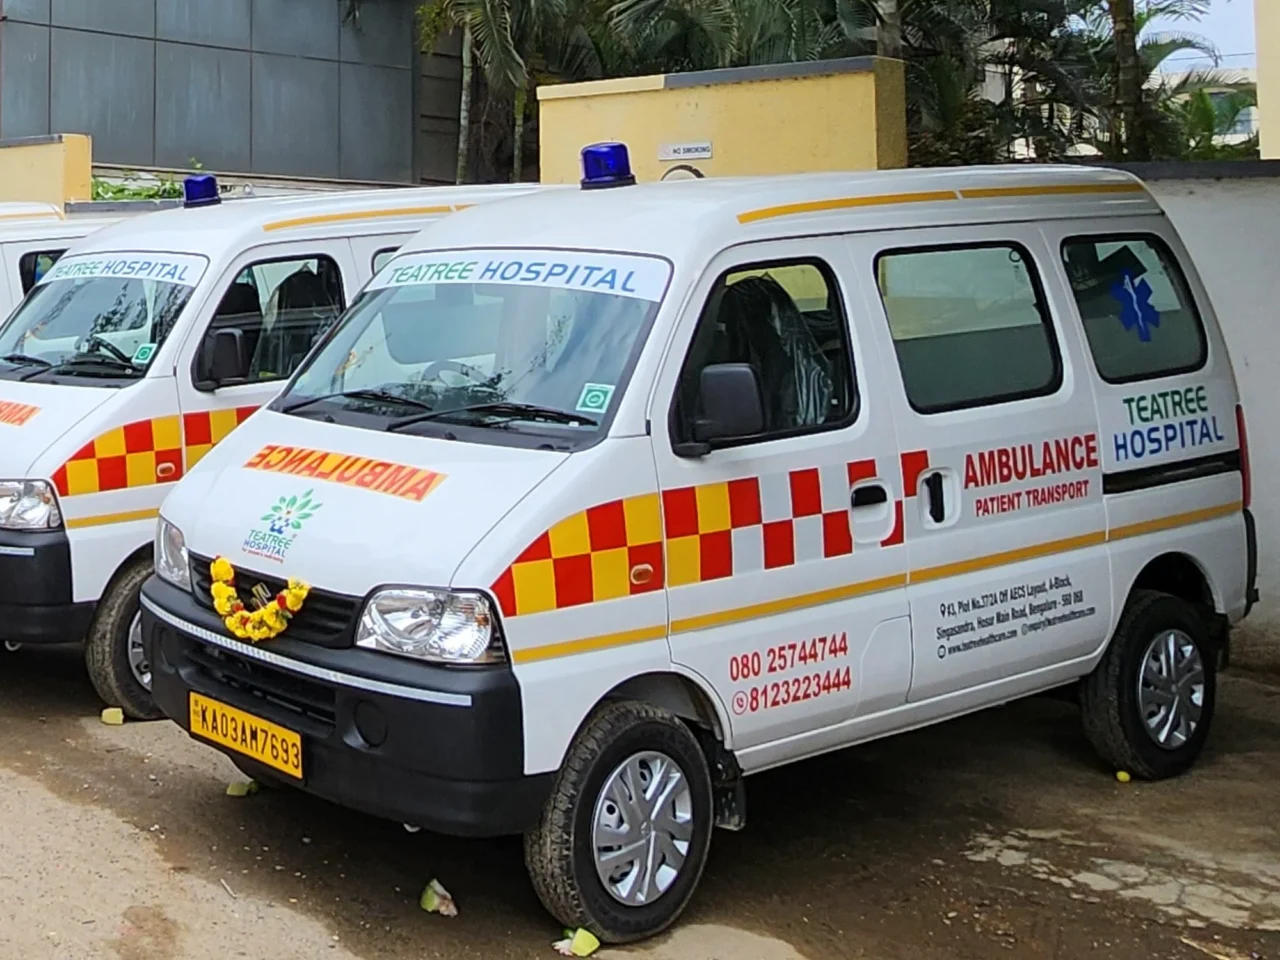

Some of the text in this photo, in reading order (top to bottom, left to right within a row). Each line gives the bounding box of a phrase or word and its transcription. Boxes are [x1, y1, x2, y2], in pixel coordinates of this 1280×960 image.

[100, 260, 189, 281] HOSPITAL
[386, 261, 636, 293] TEATREE HOSPITAL
[1123, 385, 1208, 425] TEATREE
[1113, 416, 1224, 462] HOSPITAL
[964, 433, 1098, 490] AMBULANCE
[975, 480, 1089, 517] PATIENT TRANSPORT
[244, 540, 285, 558] HOSPITAL
[248, 529, 293, 550] TEATREE
[957, 599, 971, 614] Plot
[1010, 585, 1026, 601] AECS
[996, 611, 1010, 624] Main
[730, 631, 848, 681] 080 25744744
[749, 666, 851, 712] 8123223444
[200, 703, 300, 769] KA03AM7693
